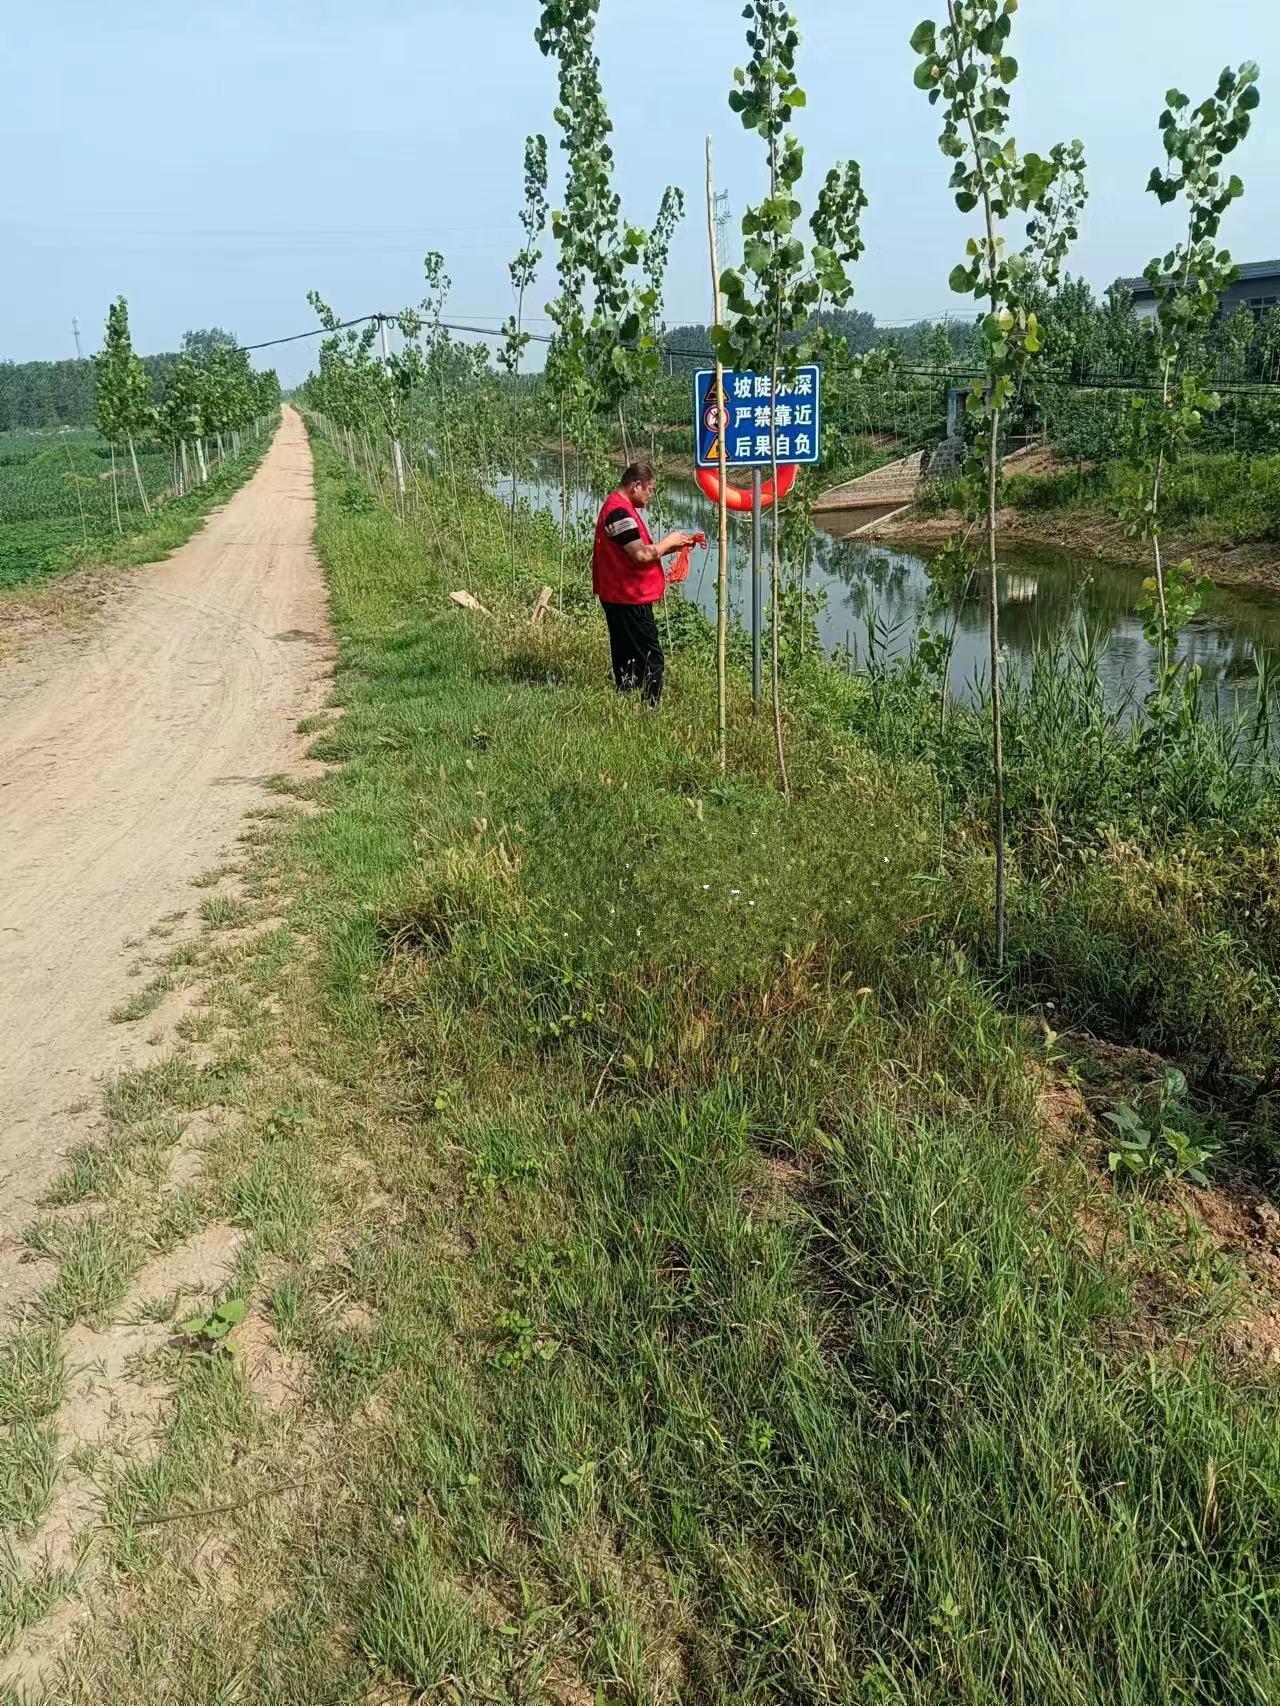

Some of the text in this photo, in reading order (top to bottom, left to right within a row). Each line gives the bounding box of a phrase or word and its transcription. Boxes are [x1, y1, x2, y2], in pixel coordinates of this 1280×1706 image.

[734, 404, 812, 428] 严禁靠近
[734, 433, 811, 457] 后果自负
